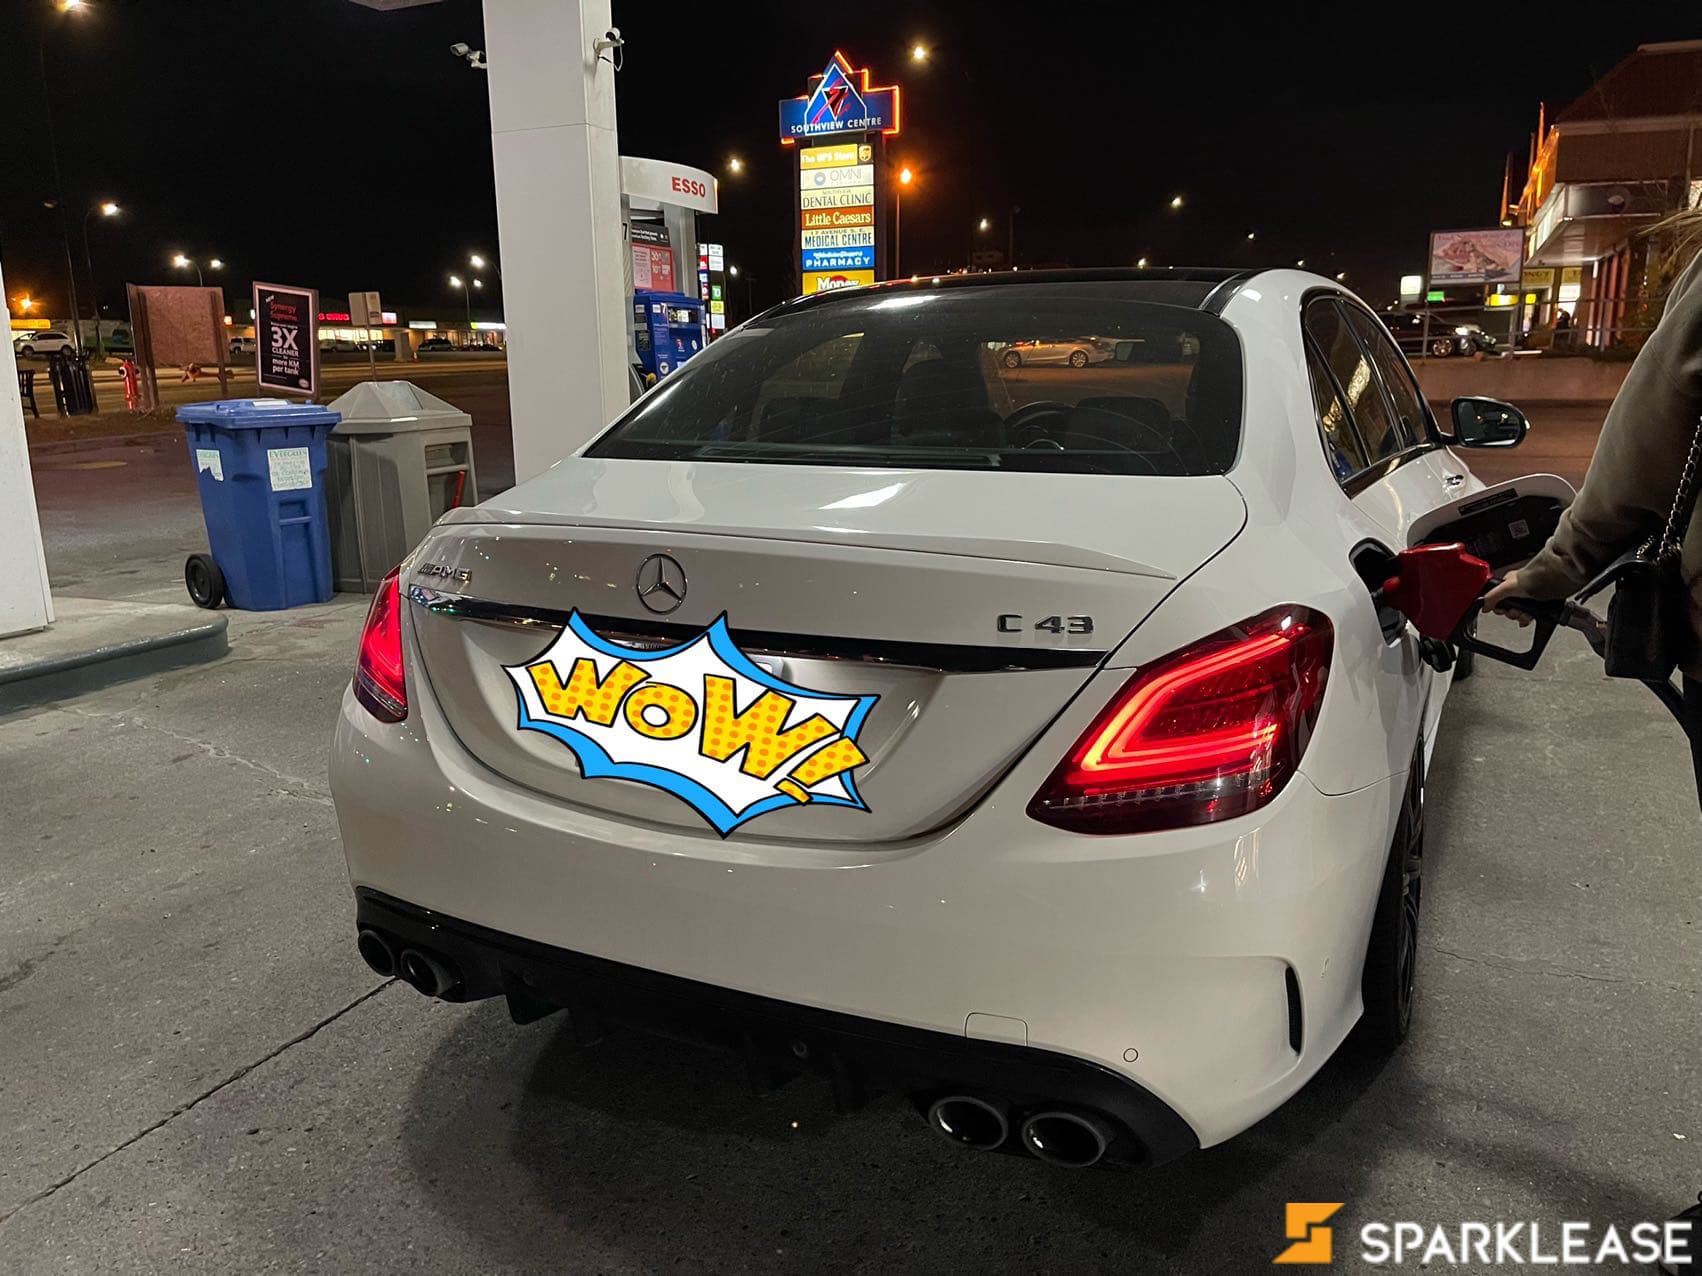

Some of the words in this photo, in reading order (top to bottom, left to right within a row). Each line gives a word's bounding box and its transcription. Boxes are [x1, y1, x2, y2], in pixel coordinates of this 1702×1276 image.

[791, 121, 844, 133] SOUTHVIEW
[848, 117, 882, 128] CENTRE
[831, 168, 862, 181] OMNI
[672, 176, 706, 198] ESSO
[803, 196, 838, 208] DENTAL
[840, 193, 872, 205] CLINIC
[805, 212, 831, 226] Little
[833, 211, 871, 224] Caesars
[805, 235, 839, 247] MEDICAL
[842, 232, 872, 246] CENTRE
[806, 256, 870, 267] PHARMACY
[271, 326, 299, 350] 3X
[272, 347, 299, 357] CLEANER
[272, 365, 283, 373] per
[284, 366, 300, 375] tank
[289, 360, 300, 368] KM
[997, 614, 1022, 633] C
[1034, 616, 1094, 634] 43
